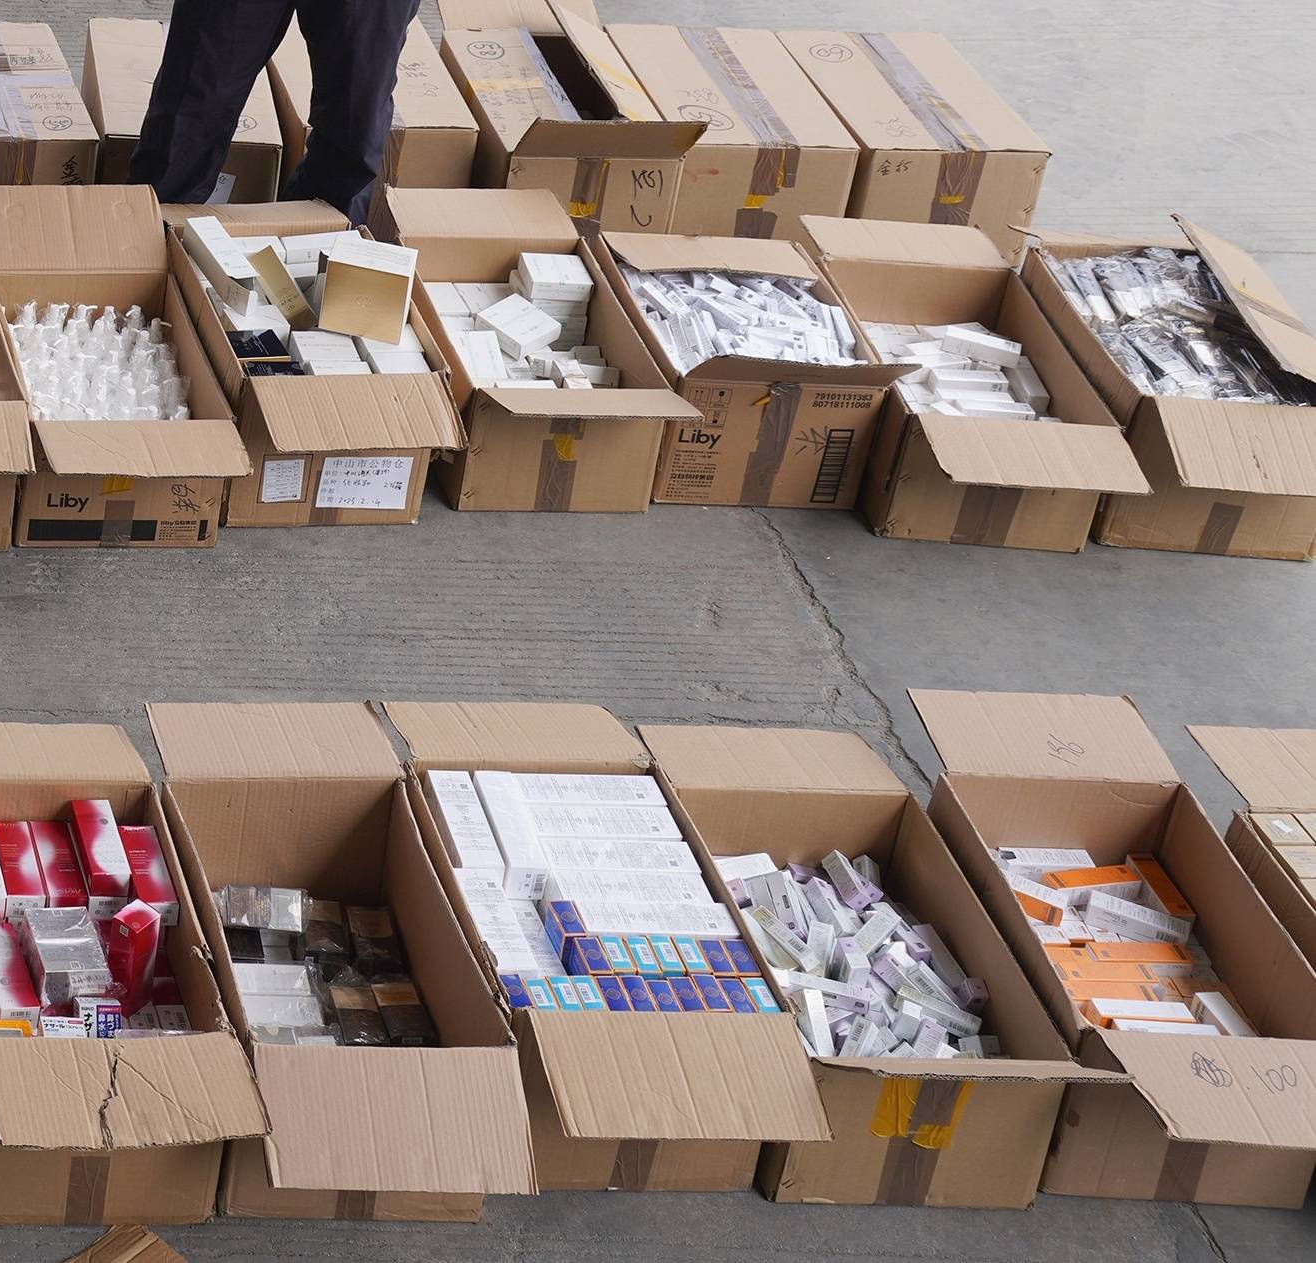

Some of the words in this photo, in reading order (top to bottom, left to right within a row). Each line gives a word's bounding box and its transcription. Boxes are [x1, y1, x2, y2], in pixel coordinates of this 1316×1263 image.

[814, 392, 873, 401] 79101131383
[812, 401, 872, 409] 80718111008
[678, 428, 721, 449] Liby
[332, 458, 405, 469] 中山市公物仓
[47, 493, 89, 513] Liby
